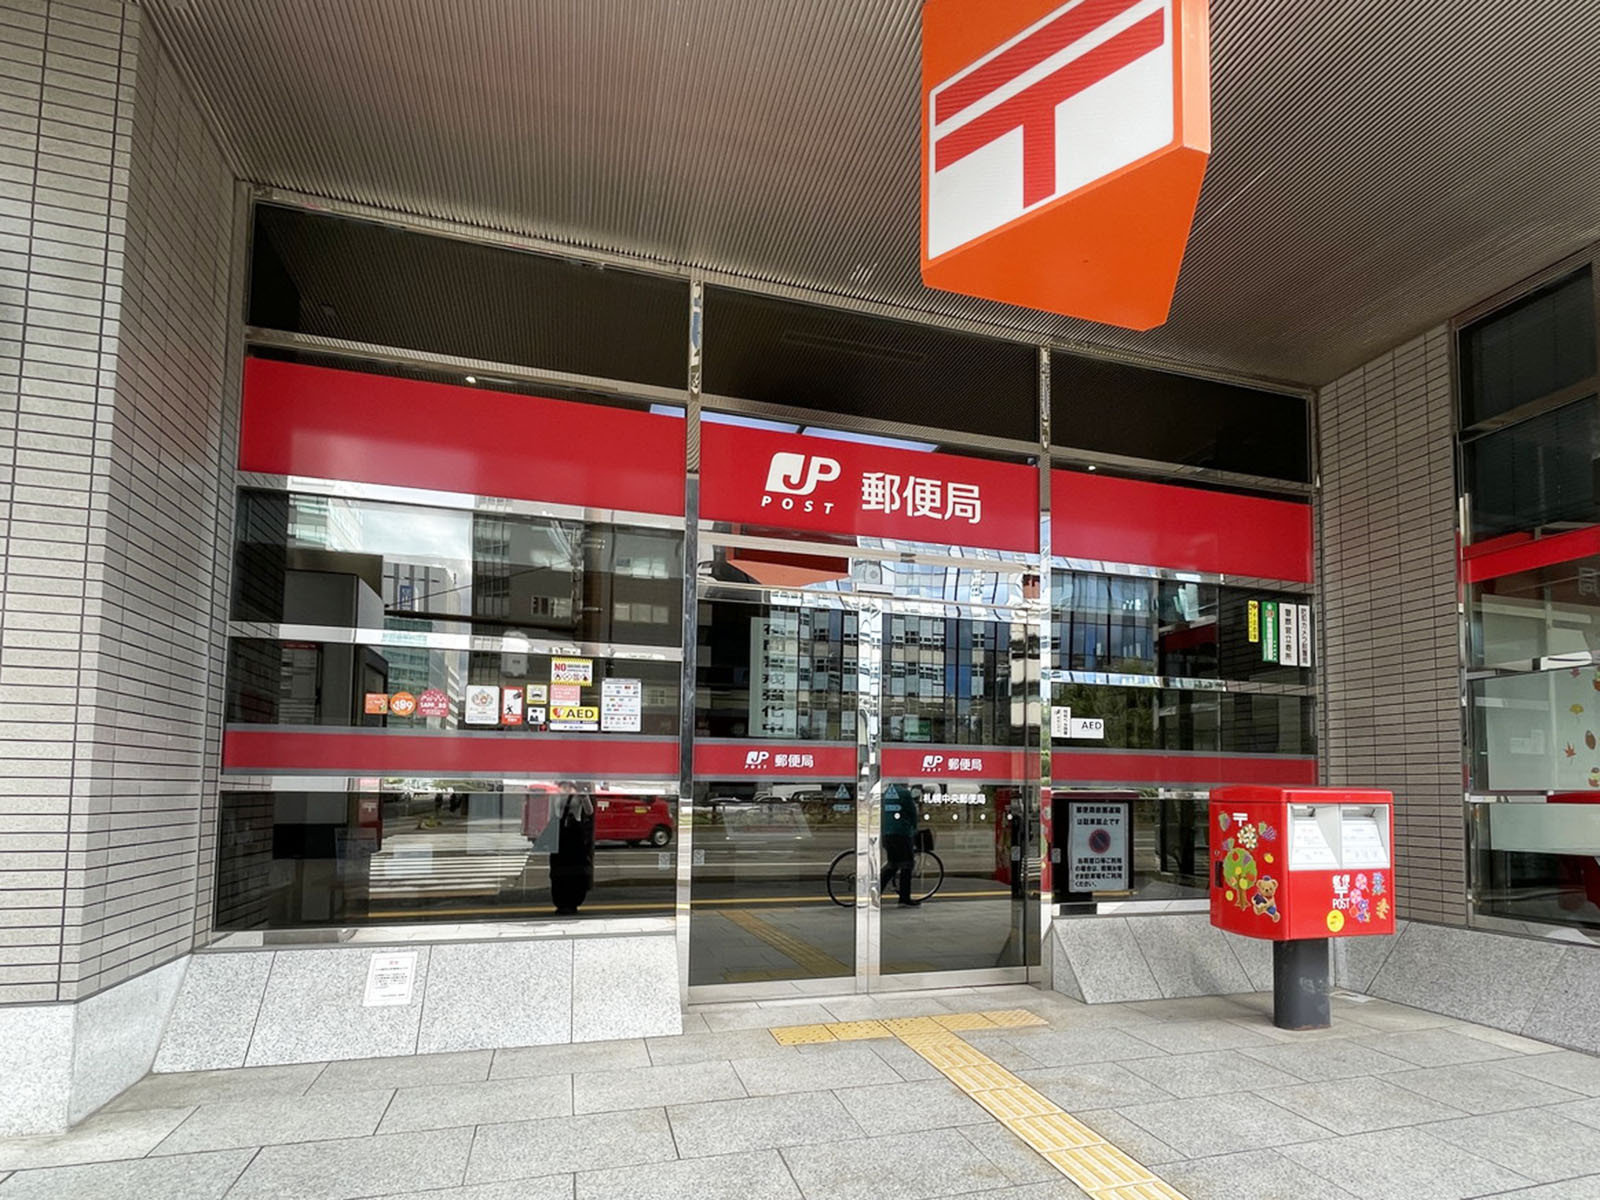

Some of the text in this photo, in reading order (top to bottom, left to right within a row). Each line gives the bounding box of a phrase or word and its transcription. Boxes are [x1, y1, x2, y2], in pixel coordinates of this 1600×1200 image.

[861, 472, 982, 524] 郵便局
[760, 495, 834, 515] POST
[554, 663, 567, 672] NO
[566, 709, 594, 718] AED
[1081, 721, 1102, 729] AED
[774, 754, 814, 768] 郵便局
[947, 758, 983, 771] 郵便局
[923, 793, 986, 805] 札幌中央郵便局
[1332, 898, 1350, 909] POST
